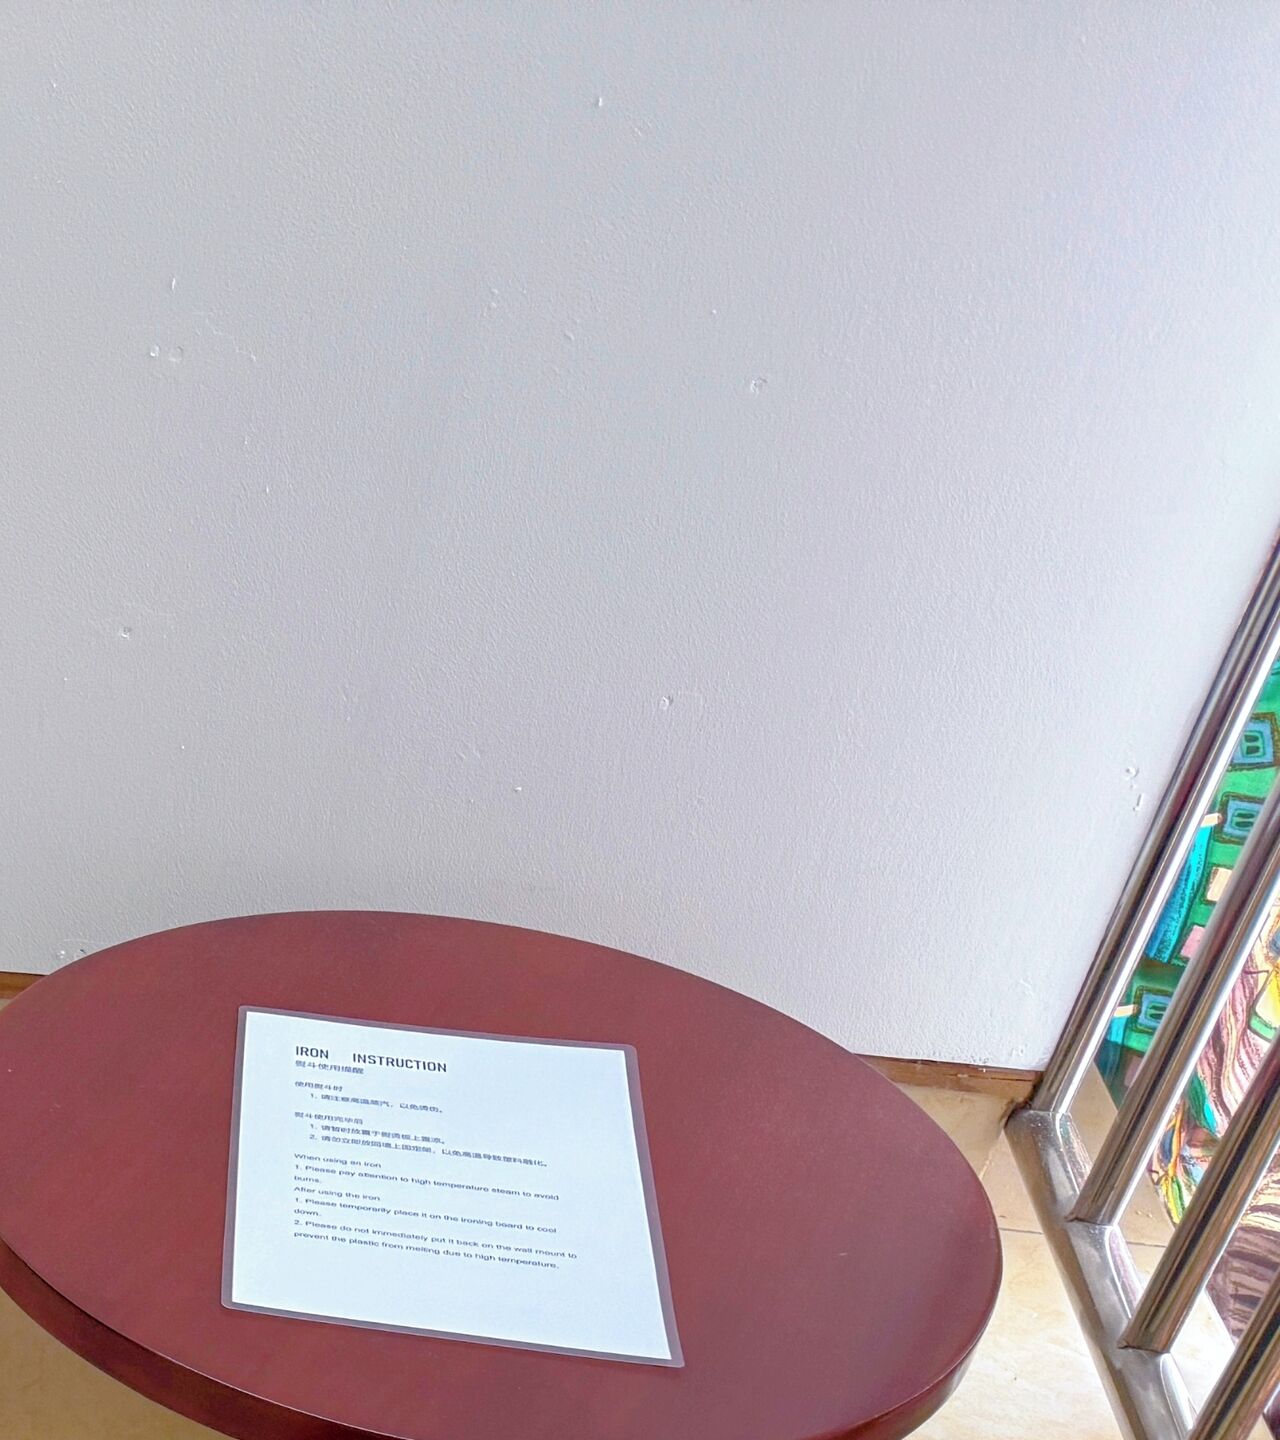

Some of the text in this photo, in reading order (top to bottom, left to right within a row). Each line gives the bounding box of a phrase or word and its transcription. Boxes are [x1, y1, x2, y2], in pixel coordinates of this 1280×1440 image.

[296, 1046, 447, 1073] IRON INSTRUCTION
[294, 1153, 321, 1161] When
[323, 1156, 348, 1165] using
[305, 1165, 336, 1174] Please
[412, 1178, 431, 1186] high
[433, 1180, 489, 1192] temperature
[318, 1190, 343, 1198] using
[305, 1198, 337, 1207] Please
[461, 1217, 493, 1226] ironing
[495, 1221, 522, 1229] board
[294, 1232, 329, 1240] prevent
[349, 1238, 379, 1246] plastic
[382, 1242, 403, 1250] from
[475, 1253, 496, 1261] high
[305, 1221, 337, 1230] Please
[535, 1249, 566, 1258] mount
